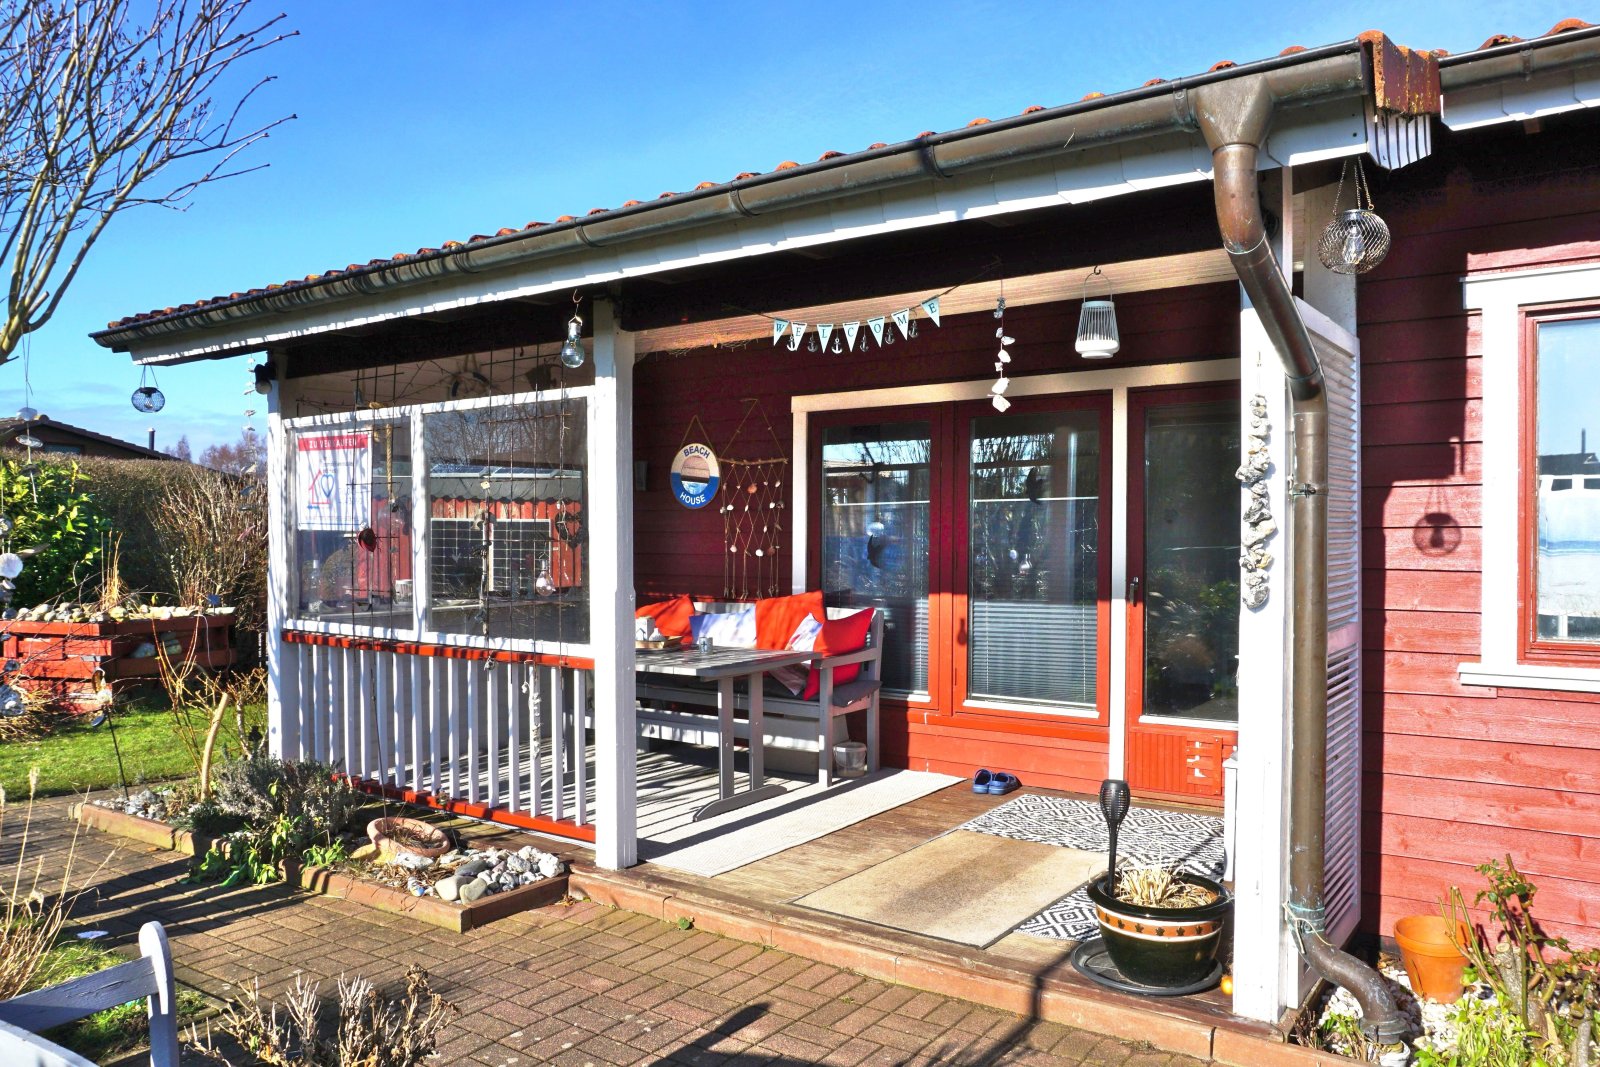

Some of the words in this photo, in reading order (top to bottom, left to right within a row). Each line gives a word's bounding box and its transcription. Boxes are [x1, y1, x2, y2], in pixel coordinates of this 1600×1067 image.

[776, 303, 937, 338] WELCOME
[309, 440, 318, 448] ZU
[320, 438, 357, 448] VERAUFEN
[683, 445, 710, 459] BEACH
[680, 491, 706, 505] HOUSE
